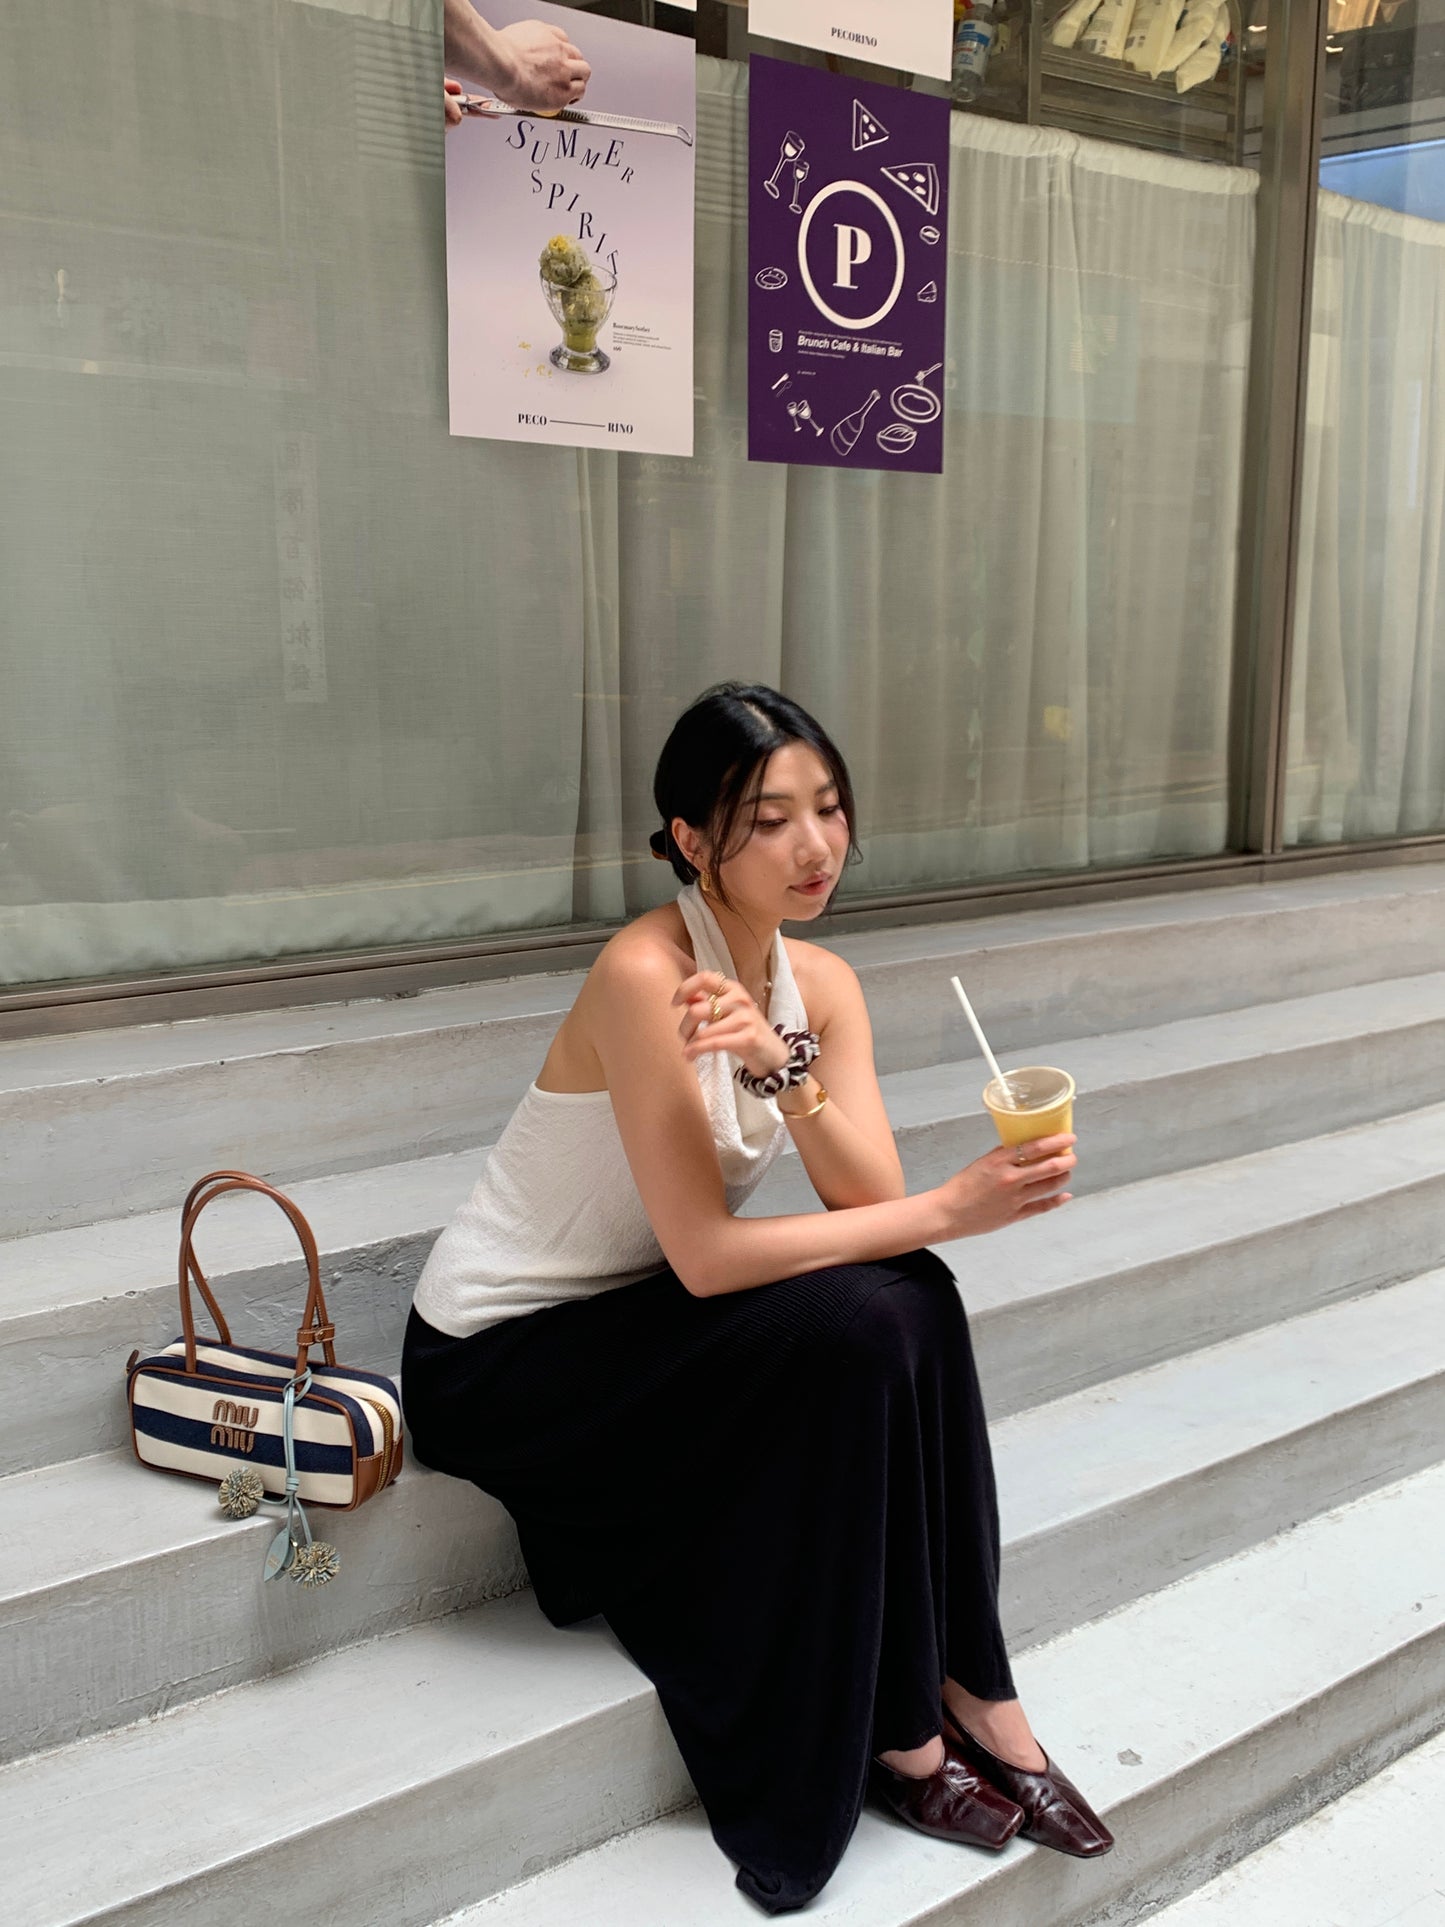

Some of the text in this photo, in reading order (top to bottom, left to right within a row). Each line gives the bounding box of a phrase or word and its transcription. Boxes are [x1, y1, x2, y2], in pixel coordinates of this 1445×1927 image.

[831, 27, 878, 47] PECORINO
[505, 120, 634, 184] SUMMER
[530, 168, 620, 275] SPIRIT
[832, 223, 872, 290] P
[797, 334, 830, 349] Brunch
[830, 339, 852, 352] Cafe
[852, 341, 860, 353] &
[860, 343, 887, 356] Italian
[887, 346, 904, 358] Bar
[518, 413, 634, 434] PECO RINO
